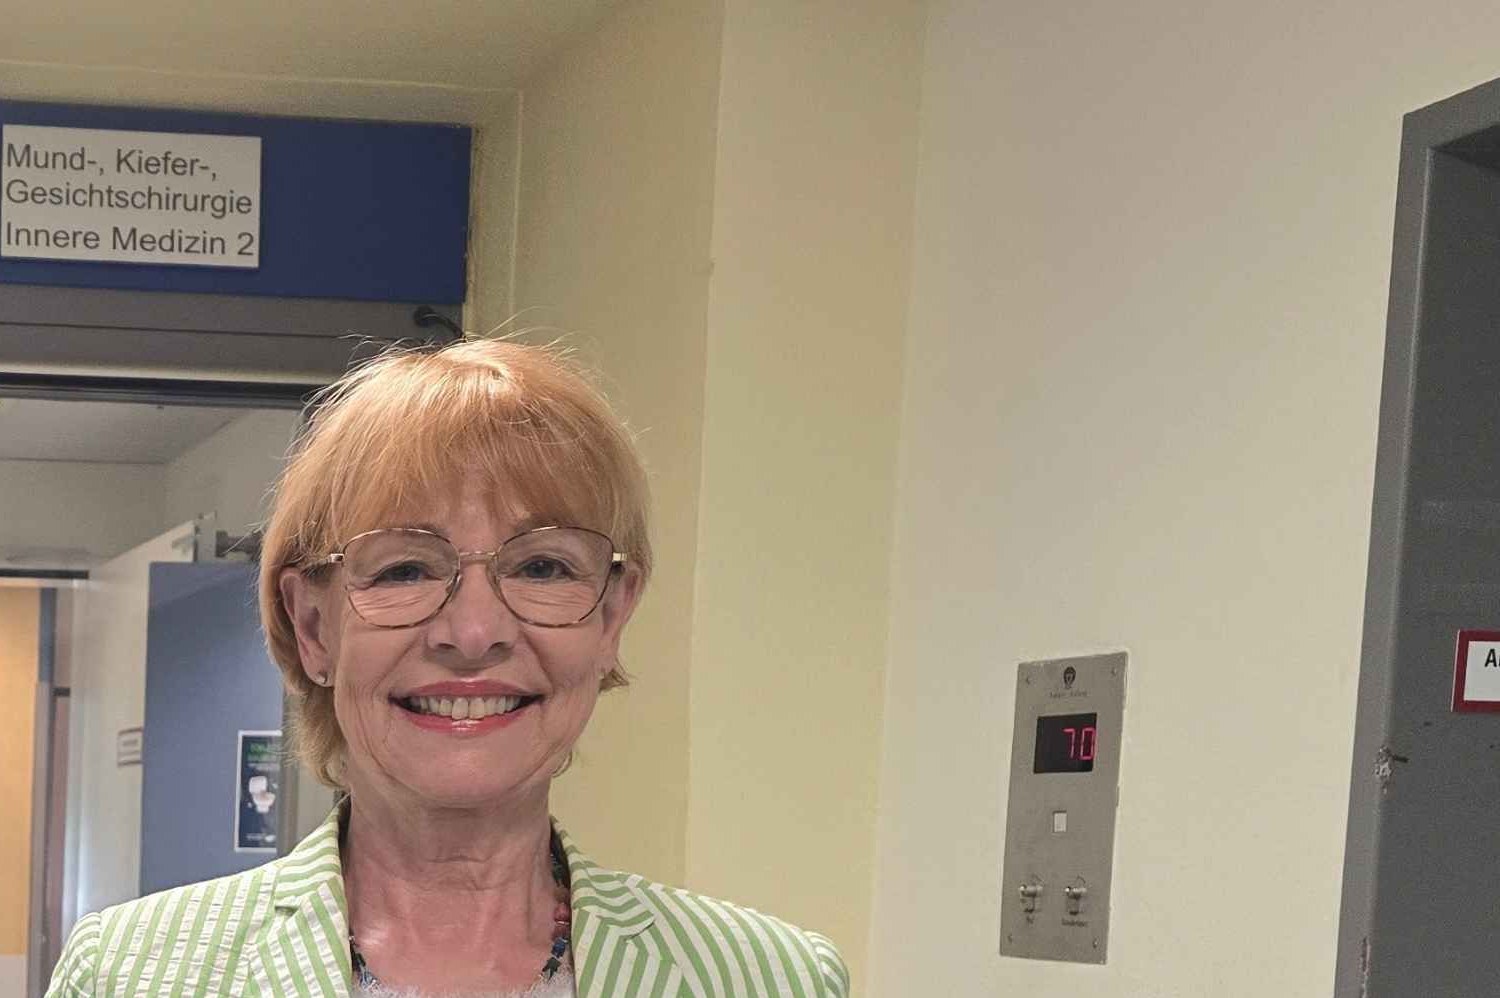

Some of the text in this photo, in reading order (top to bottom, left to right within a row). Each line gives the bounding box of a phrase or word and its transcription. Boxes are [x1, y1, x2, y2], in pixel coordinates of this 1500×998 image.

[6, 143, 218, 181] Mund-, Kiefer-,
[5, 178, 253, 220] Gesichtschirurgie
[6, 221, 255, 256] Innere Medizin 2
[1484, 648, 1500, 668] A
